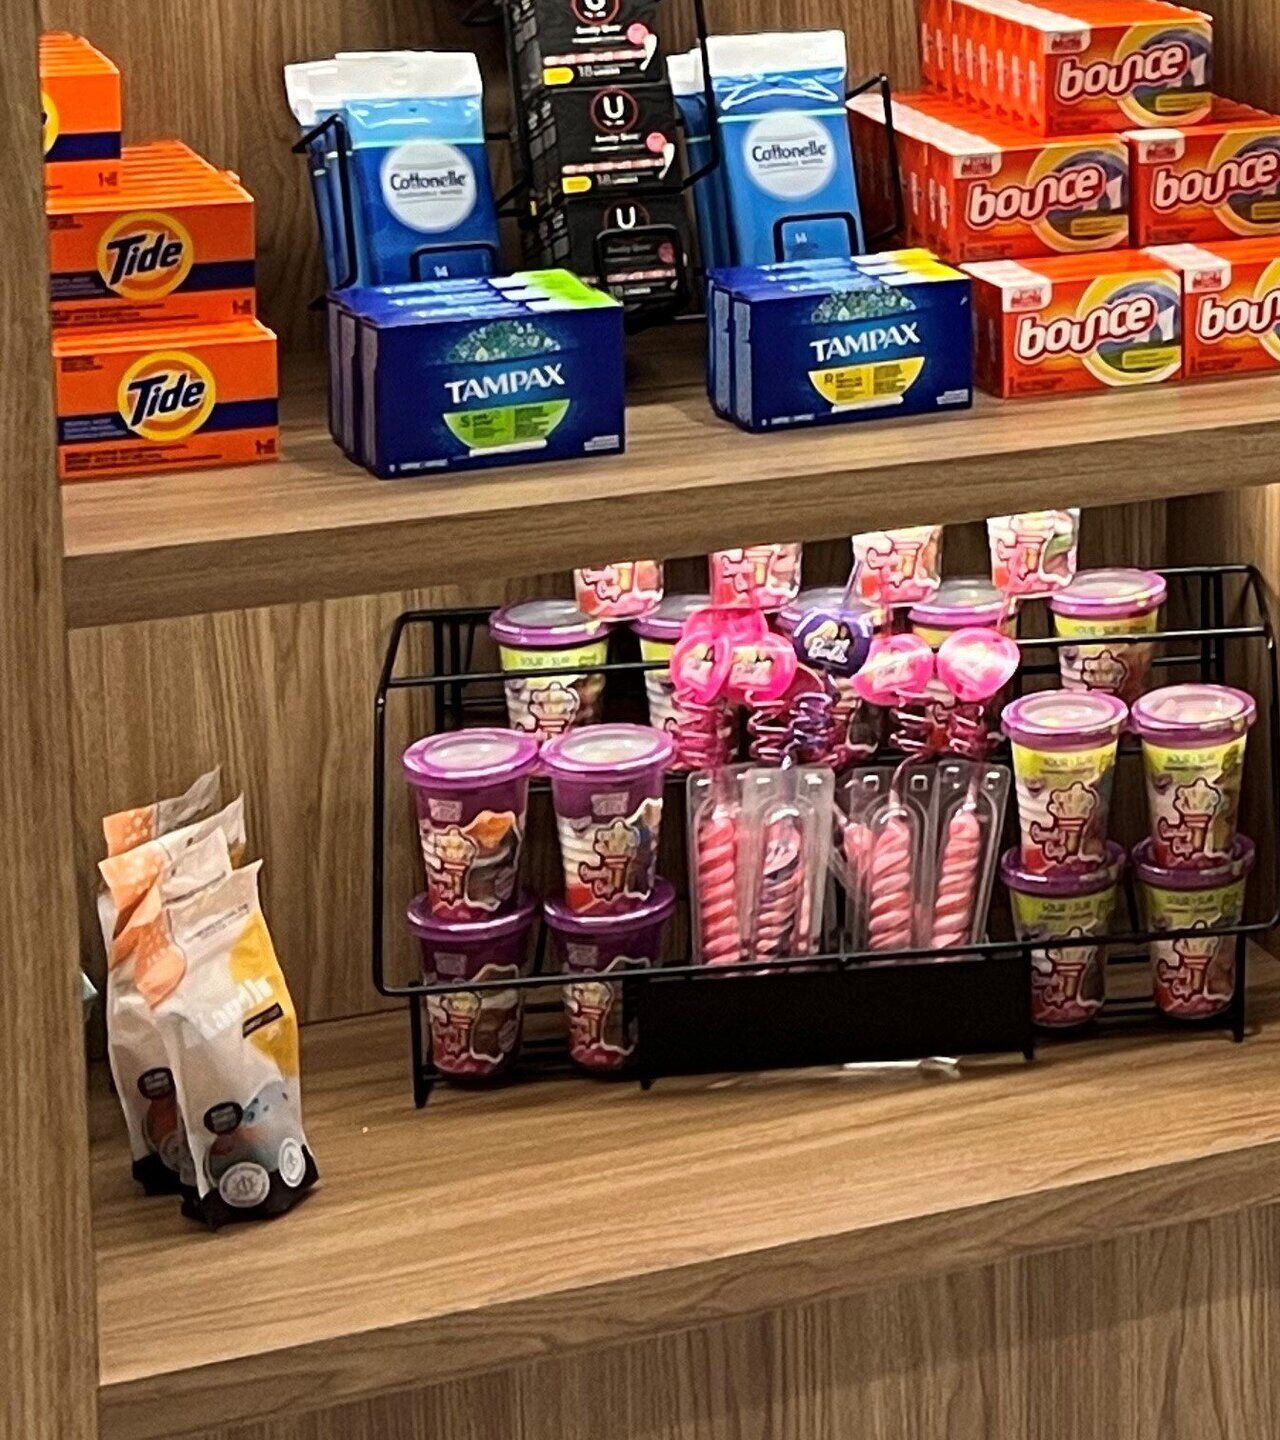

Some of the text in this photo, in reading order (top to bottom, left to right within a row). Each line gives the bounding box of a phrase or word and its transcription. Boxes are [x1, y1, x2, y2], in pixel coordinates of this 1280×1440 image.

[1057, 43, 1186, 98] bounce
[751, 139, 827, 162] Cottonelle
[390, 170, 467, 191] Cottonelle
[969, 167, 1102, 226] bounce
[1154, 152, 1280, 210] bounce
[106, 231, 184, 287] Tide
[809, 321, 921, 363] TAMPAX
[1018, 297, 1154, 359] bounce
[127, 369, 206, 427] Tide
[444, 363, 566, 404] TAMPAX
